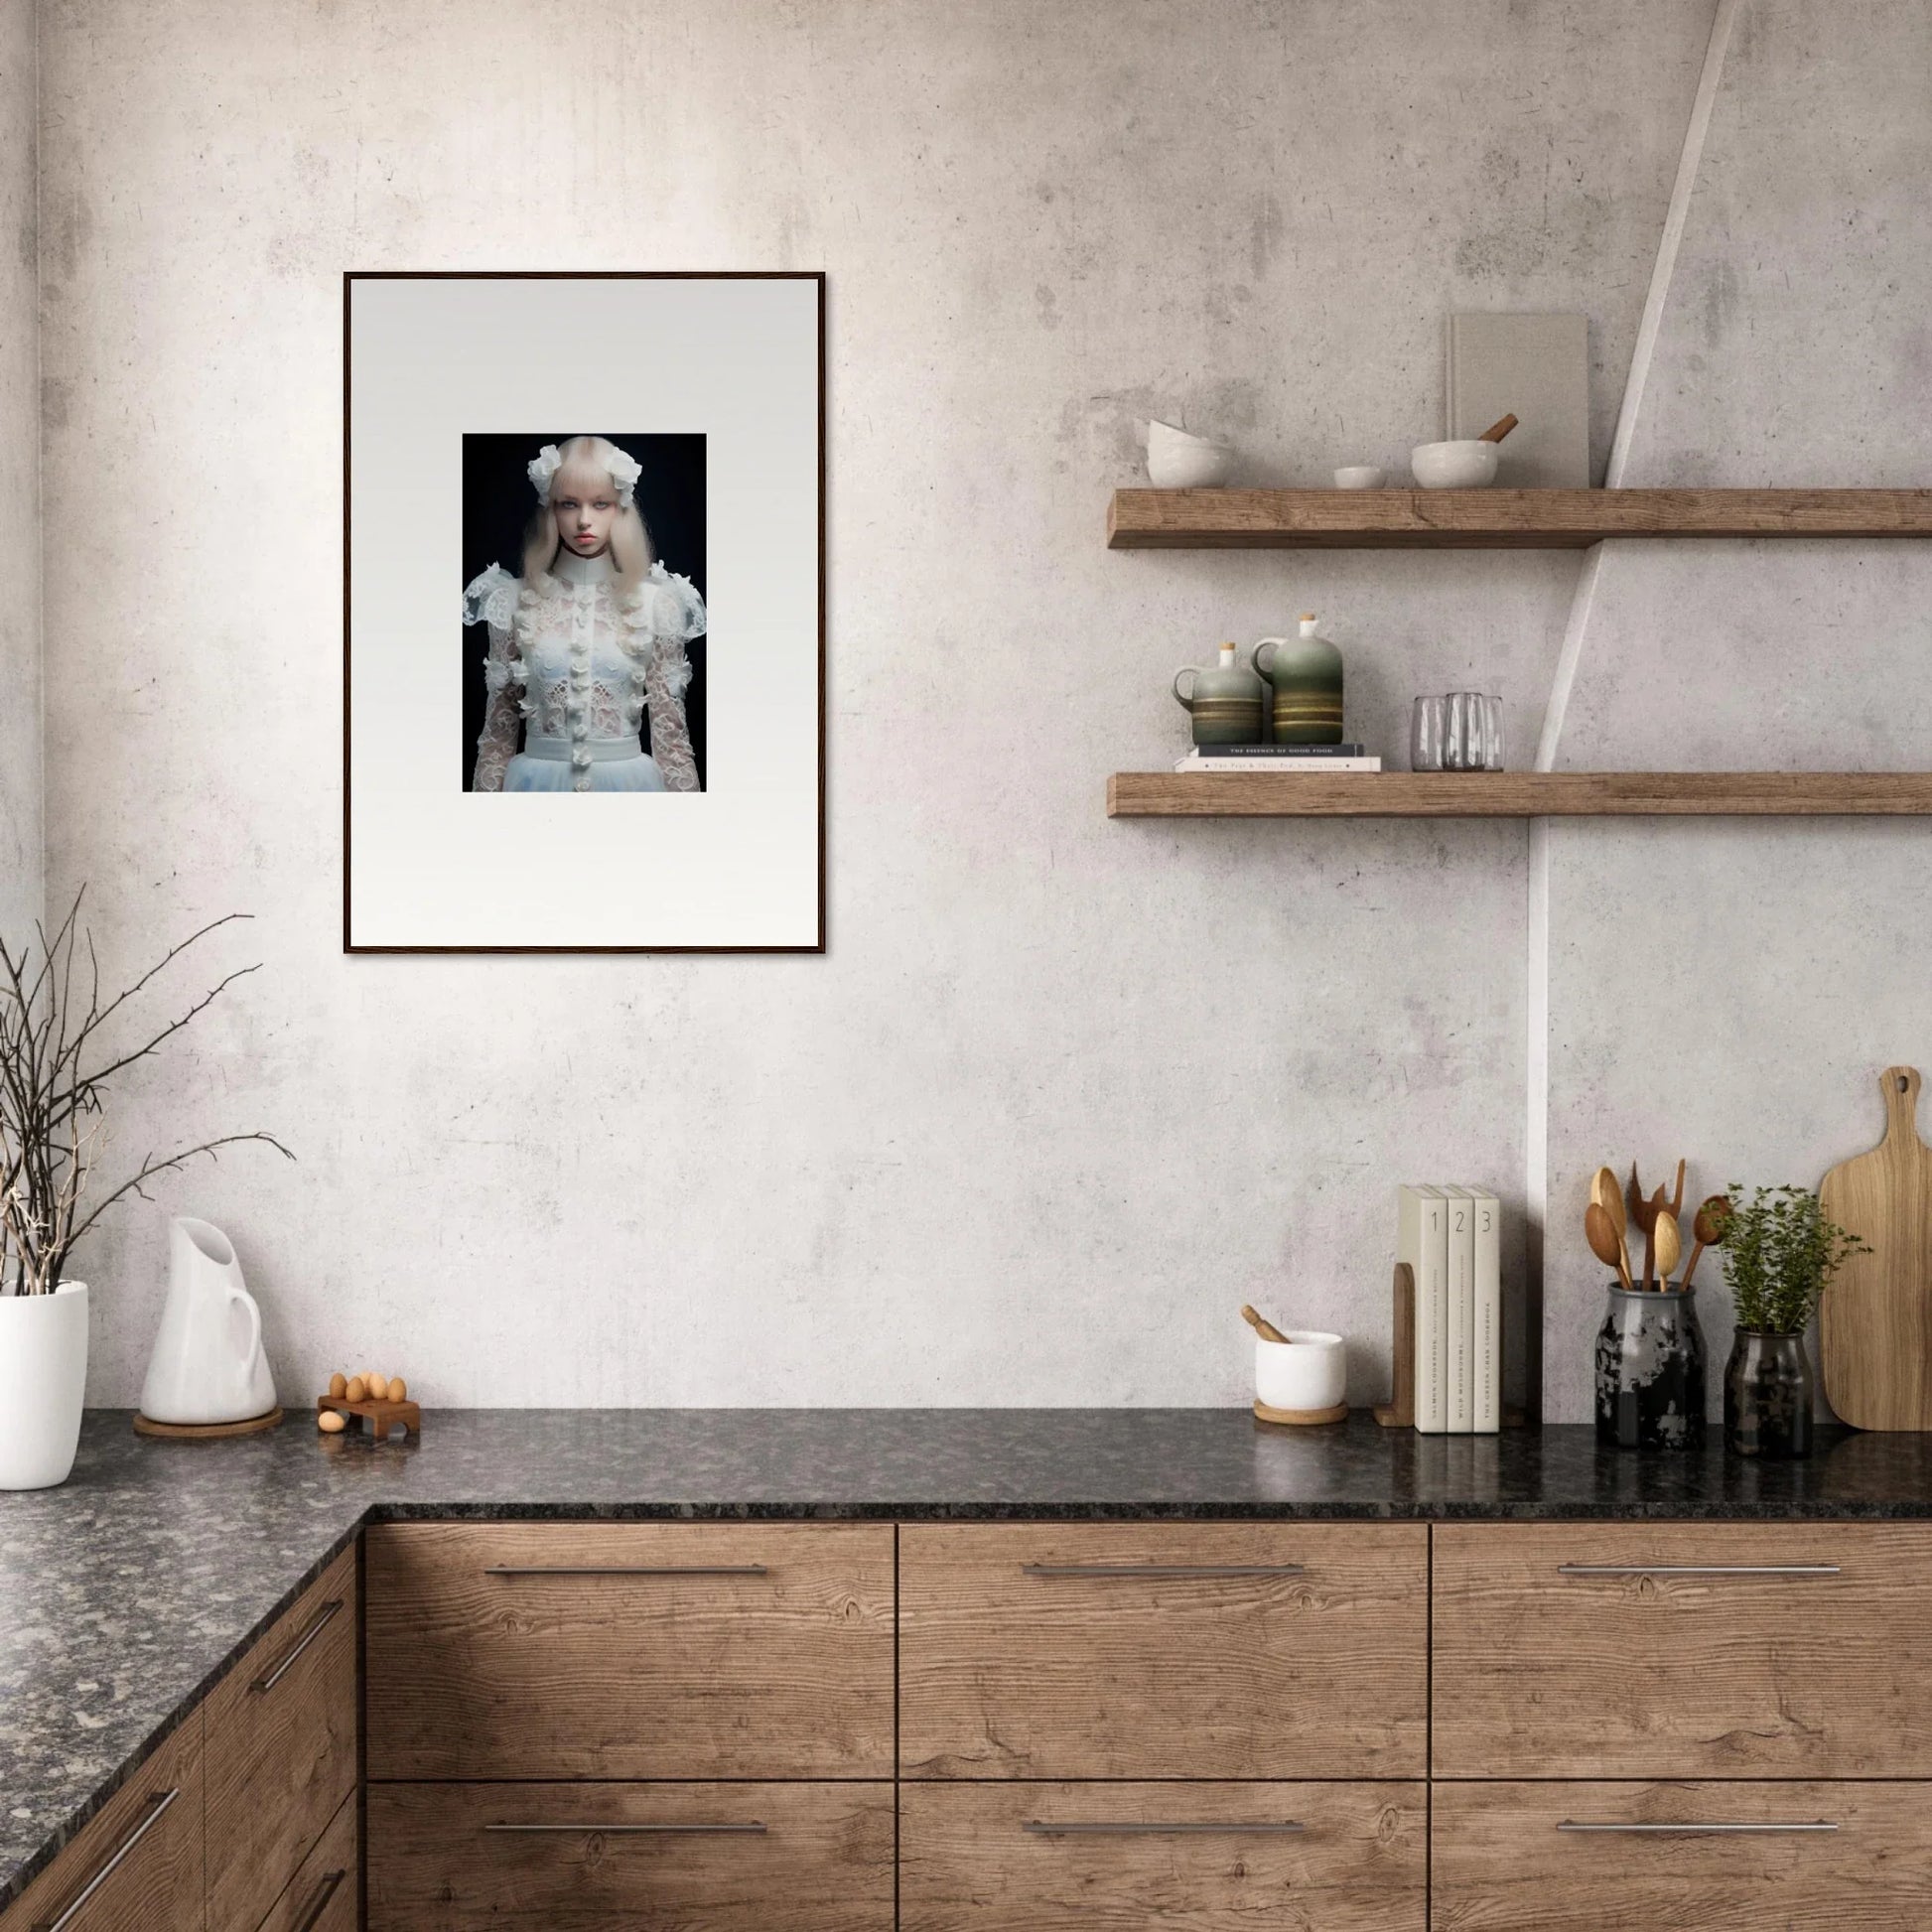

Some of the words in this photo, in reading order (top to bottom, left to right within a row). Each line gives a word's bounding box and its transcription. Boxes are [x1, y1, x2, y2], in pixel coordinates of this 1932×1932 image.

[1431, 1211, 1437, 1232] 1
[1455, 1211, 1464, 1232] 2
[1482, 1211, 1491, 1232] 3
